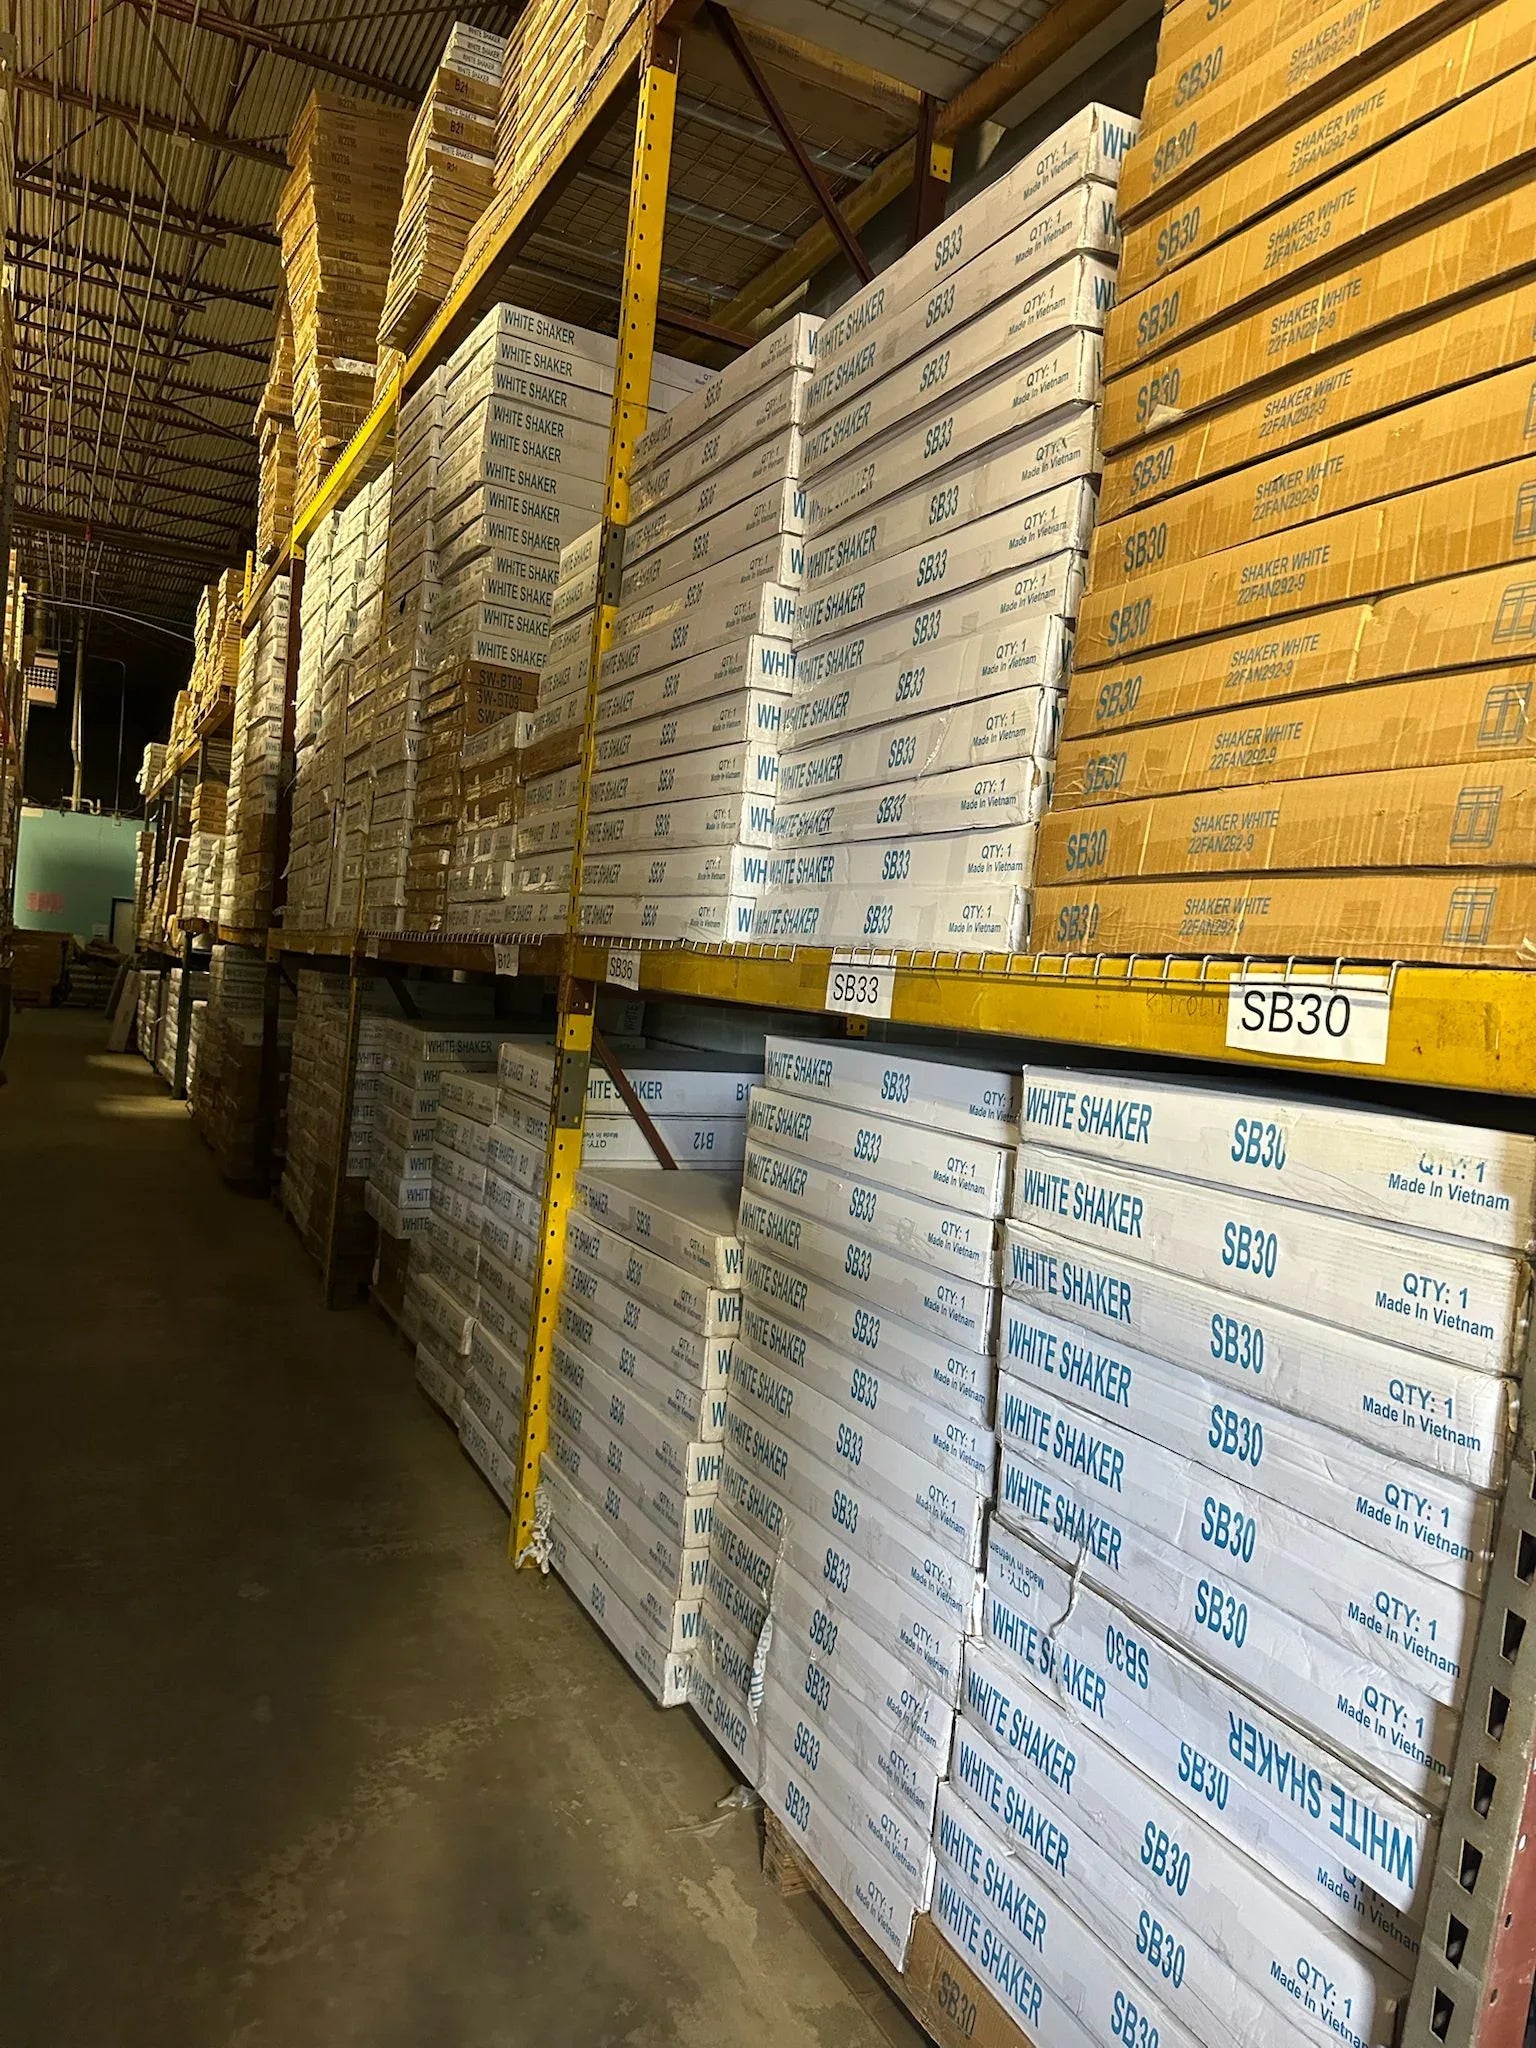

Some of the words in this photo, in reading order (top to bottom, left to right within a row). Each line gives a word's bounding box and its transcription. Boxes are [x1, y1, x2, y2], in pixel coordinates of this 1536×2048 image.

[455, 79, 468, 95] B21
[1175, 46, 1223, 109] SB30
[451, 120, 464, 134] B21
[1293, 116, 1342, 157] SHAKER
[1345, 89, 1386, 125] WHITE
[1036, 149, 1060, 176] QTY:
[1063, 141, 1067, 155] 1
[1152, 121, 1197, 184] SB30
[1156, 207, 1199, 266] SB30
[1268, 209, 1314, 250] SHAKER
[1318, 188, 1357, 223] WHITE
[934, 225, 963, 272] SB33
[505, 309, 534, 332] WHITE
[536, 321, 574, 345] SHAKER
[1137, 291, 1180, 348] SB30
[1271, 299, 1316, 334] SHAKER
[1322, 278, 1362, 312] WHITE
[502, 343, 531, 365] WHITE
[534, 353, 572, 376] SHAKER
[497, 373, 526, 394] WHITE
[529, 383, 567, 407] SHAKER
[1131, 445, 1175, 496] SB30
[1256, 470, 1303, 501] SHAKER
[1306, 455, 1344, 483] WHITE
[1123, 522, 1167, 574] SB30
[1241, 553, 1288, 584] SHAKER
[1292, 546, 1330, 571] WHITE
[1107, 600, 1152, 646] SB30
[480, 669, 522, 691] SW-BT09
[1096, 676, 1141, 721] SB30
[1083, 752, 1127, 795] SB30
[1192, 814, 1239, 833] SHAKER
[1241, 809, 1280, 829] WHITE
[769, 859, 795, 883] WHITE
[796, 855, 834, 883] SHAKER
[882, 849, 911, 879] SB33
[968, 864, 985, 873] Made
[986, 863, 992, 871] In
[994, 861, 1023, 871] Vietnam
[981, 844, 1004, 859] QTY:
[1007, 843, 1012, 857] 1
[1065, 829, 1108, 872] SB30
[756, 909, 782, 935] WHITE
[782, 906, 819, 934] SHAKER
[864, 905, 894, 935] SB33
[948, 922, 965, 932] Made
[966, 922, 973, 931] In
[974, 922, 1001, 932] Vietnam
[962, 905, 983, 919] QTY:
[987, 905, 992, 918] 1
[1057, 903, 1099, 942] SB30
[498, 953, 510, 968] B12
[609, 956, 633, 979] SB36
[833, 973, 879, 1004] SB33
[1241, 990, 1351, 1038] SB30
[428, 1041, 454, 1053] WHITE
[457, 1040, 492, 1053] SHAKER
[766, 1051, 794, 1082] WHITE
[795, 1056, 833, 1088] SHAKER
[882, 1071, 910, 1104] SB33
[693, 1131, 714, 1150] B12
[751, 1095, 775, 1129] WHITE
[775, 1107, 812, 1142] SHAKER
[1026, 1087, 1076, 1131] WHITE
[1080, 1095, 1153, 1144] SHAKER
[854, 1129, 882, 1164] SB33
[947, 1157, 968, 1175] QTY:
[971, 1164, 976, 1178] 1
[1231, 1118, 1287, 1171] SB30
[933, 1169, 949, 1184] Made
[950, 1175, 957, 1186] In
[958, 1177, 985, 1195] Vietnam
[1024, 1168, 1070, 1205] WHITE
[1073, 1182, 1144, 1239] SHAKER
[1388, 1173, 1422, 1197] Made
[1427, 1182, 1444, 1199] In
[1447, 1184, 1510, 1211] Vietnam
[1222, 1222, 1278, 1278] SB30
[1012, 1244, 1059, 1287] WHITE
[1062, 1262, 1132, 1325] SHAKER
[1403, 1273, 1451, 1305] QTY:
[1458, 1288, 1469, 1309] 1
[1375, 1291, 1410, 1315] Made
[1414, 1302, 1430, 1320] In
[1432, 1304, 1494, 1341] Vietnam
[1008, 1318, 1056, 1361] WHITE
[1059, 1340, 1132, 1408] SHAKER
[1210, 1313, 1264, 1374] SB30
[1363, 1395, 1398, 1421] Made
[1401, 1408, 1416, 1427] In
[1419, 1413, 1481, 1448] Vietnam
[1389, 1379, 1436, 1413] QTY:
[1443, 1398, 1454, 1419] 1
[1003, 1392, 1051, 1452] WHITE
[1054, 1423, 1124, 1493] SHAKER
[1208, 1405, 1263, 1468] SB30
[832, 1488, 858, 1534] SB33
[1005, 1463, 1050, 1525] WHITE
[1054, 1494, 1122, 1571] SHAKER
[1201, 1496, 1256, 1563] SB30
[1356, 1497, 1395, 1525] Made
[1398, 1510, 1412, 1531] In
[1415, 1513, 1474, 1563] Vietnam
[1385, 1483, 1436, 1518] QTY:
[1440, 1507, 1451, 1528] 1
[993, 1600, 1037, 1666] WHITE
[1194, 1579, 1247, 1649] SB30
[1374, 1590, 1424, 1629] QTY:
[1428, 1619, 1438, 1641] 1
[1106, 1625, 1148, 1690] SB30
[1348, 1601, 1385, 1630] Made
[1388, 1616, 1402, 1638] In
[1405, 1621, 1460, 1678] Vietnam
[967, 1670, 1010, 1734] WHITE
[1009, 1708, 1076, 1795] SHAKER
[1338, 1694, 1371, 1728] Made
[1374, 1721, 1386, 1737] In
[1391, 1727, 1447, 1777] Vietnam
[1364, 1686, 1408, 1729] QTY:
[1415, 1718, 1424, 1738] 1
[1177, 1741, 1229, 1810] SB30
[1229, 1710, 1323, 1820] SHAKER
[785, 1780, 811, 1831] SB33
[959, 1740, 1002, 1813] WHITE
[1003, 1790, 1069, 1877] SHAKER
[1140, 1821, 1191, 1898] SB30
[1329, 1784, 1414, 1889] WHITE
[940, 1809, 981, 1883] WHITE
[981, 1863, 1048, 1954] SHAKER
[938, 1877, 980, 1953] WHITE
[980, 1925, 1043, 2029] SHAKER
[1136, 1910, 1185, 1989] SB30
[938, 1971, 975, 2037] SB30
[1297, 1957, 1336, 2006] QTY:
[1344, 1998, 1352, 2019] 1
